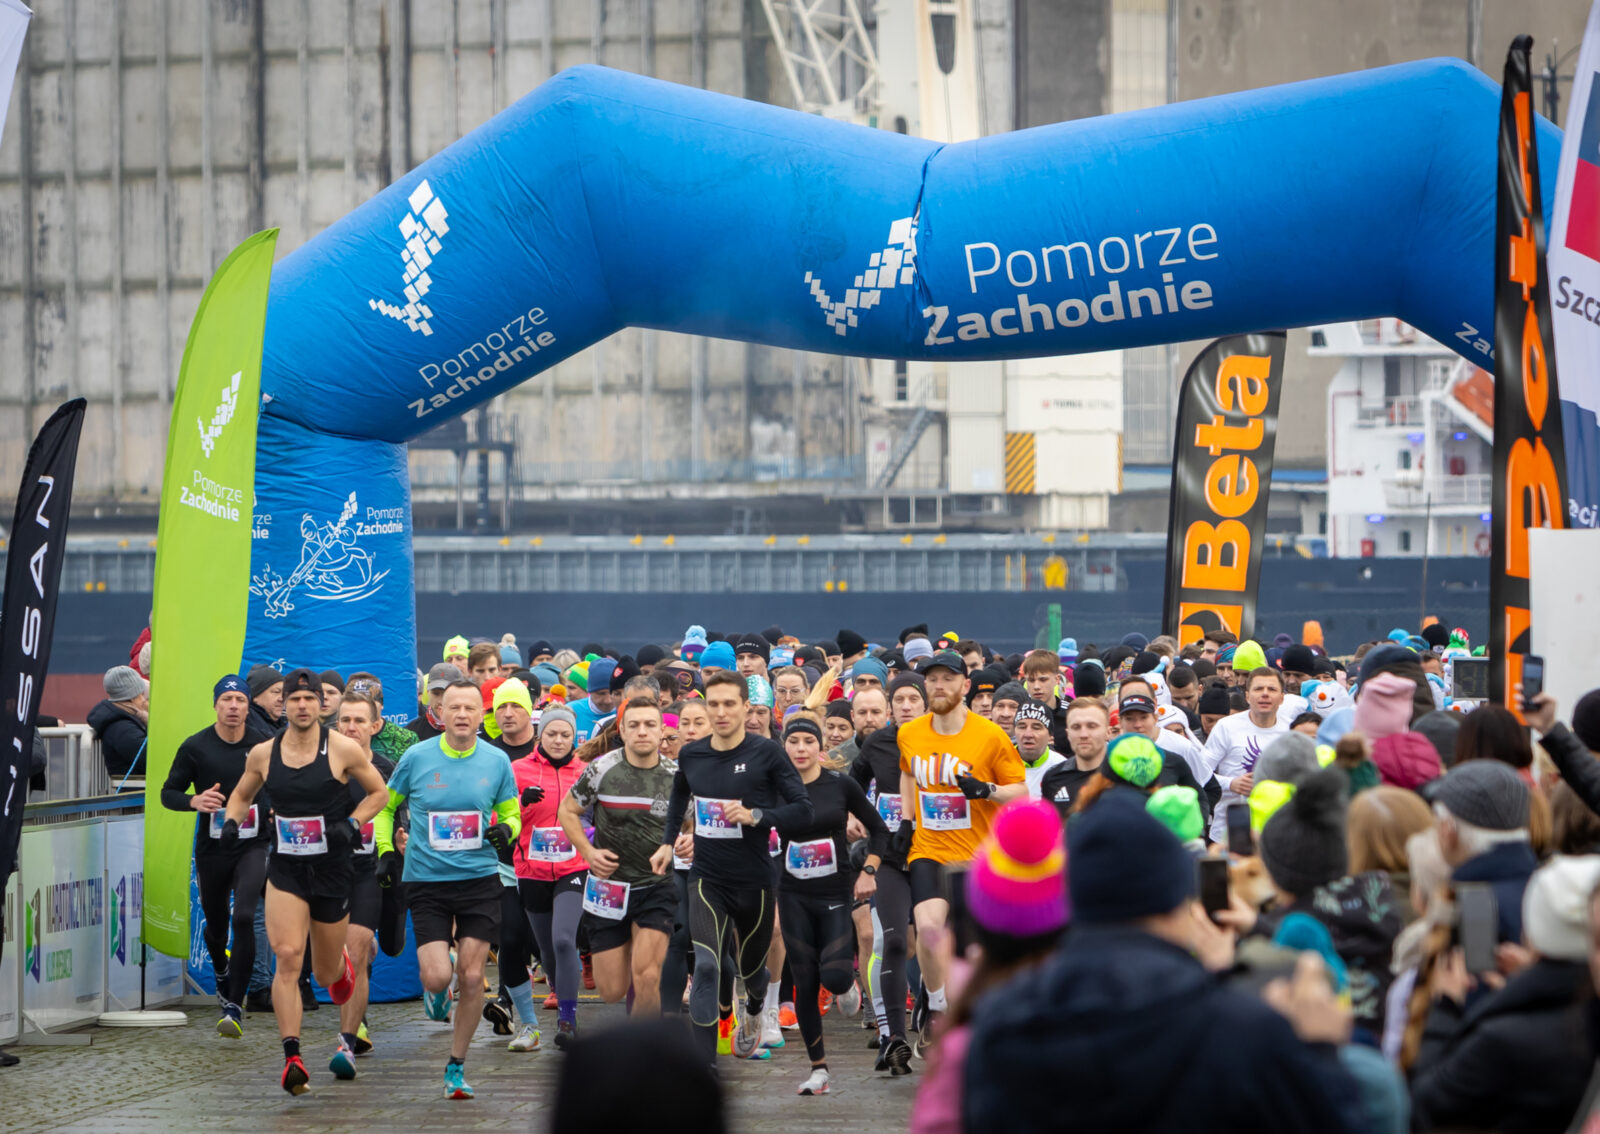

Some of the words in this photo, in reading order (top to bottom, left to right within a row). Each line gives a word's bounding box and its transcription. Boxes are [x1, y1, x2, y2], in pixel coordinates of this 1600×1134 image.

[964, 222, 1219, 294] Pomorze
[922, 272, 1214, 346] Zachodnie
[418, 307, 549, 389] Pomorze
[402, 331, 557, 418] Zachodnie
[1181, 354, 1272, 592] Beta
[193, 470, 243, 503] Pomorze
[180, 486, 240, 522] Zachodnie
[367, 506, 404, 520] Pomorze
[356, 519, 404, 537] Zachodnie
[1021, 703, 1046, 714] DLA
[705, 819, 725, 828] 280
[933, 812, 954, 822] 163
[290, 836, 310, 846] 197
[450, 831, 463, 841] 50
[799, 859, 820, 869] 277
[592, 896, 611, 908] 165
